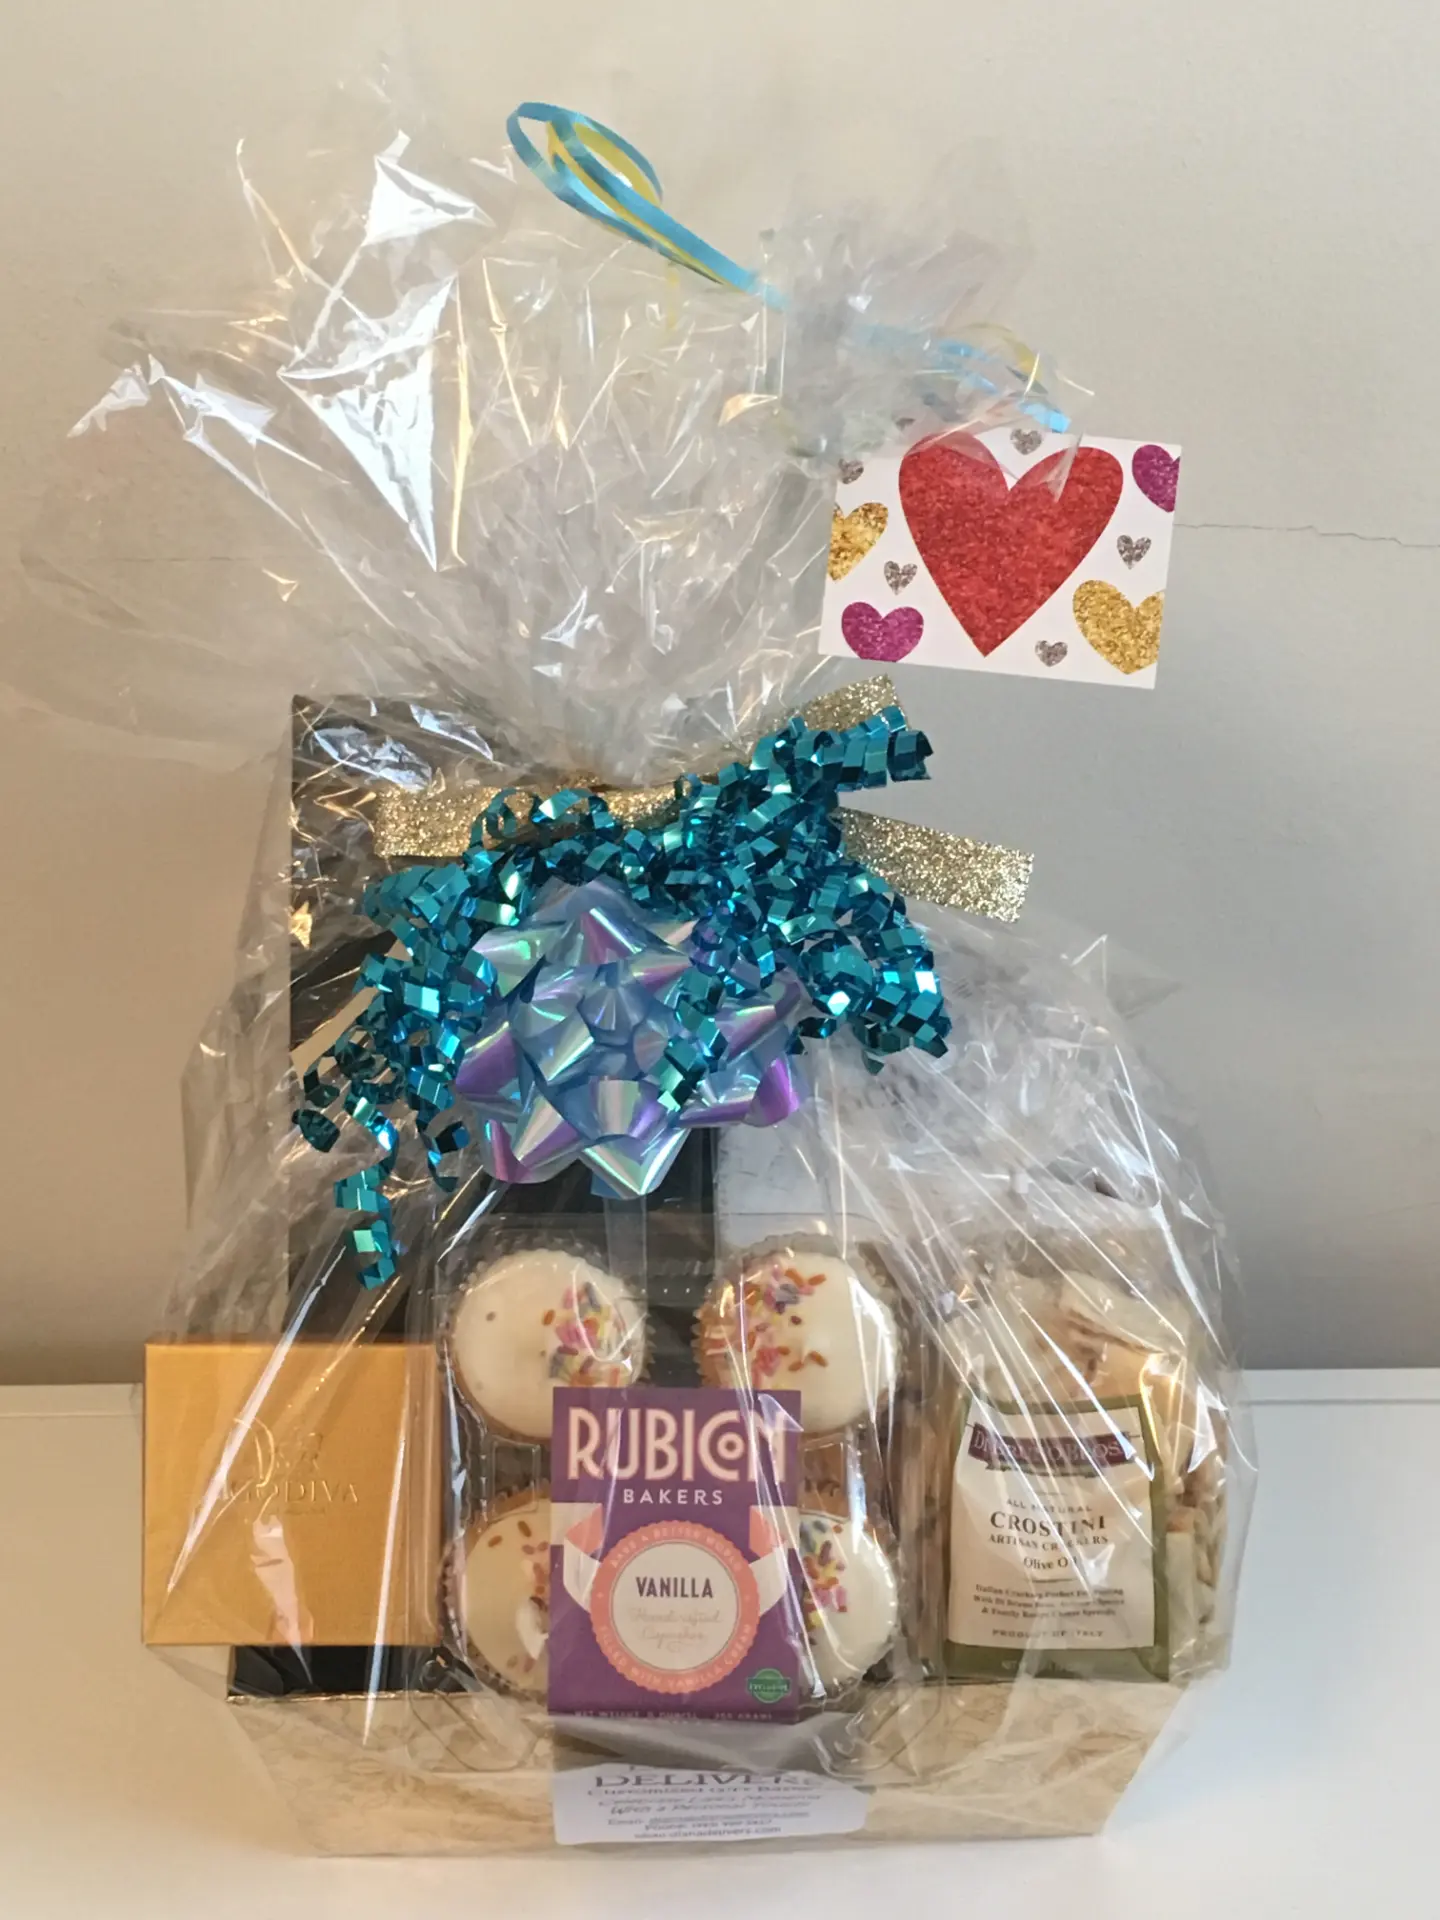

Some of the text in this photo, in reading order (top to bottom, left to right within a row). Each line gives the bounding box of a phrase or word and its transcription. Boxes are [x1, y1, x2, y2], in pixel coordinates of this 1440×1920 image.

[567, 1406, 787, 1482] RUBICON
[623, 1488, 723, 1506] BAKERS
[1006, 1499, 1027, 1510] ALL
[990, 1511, 1106, 1538] CROSTINI
[990, 1534, 1108, 1552] ARTISAN CRCKERS
[1024, 1556, 1078, 1569] Olive Ol
[636, 1577, 713, 1598] VANILLA
